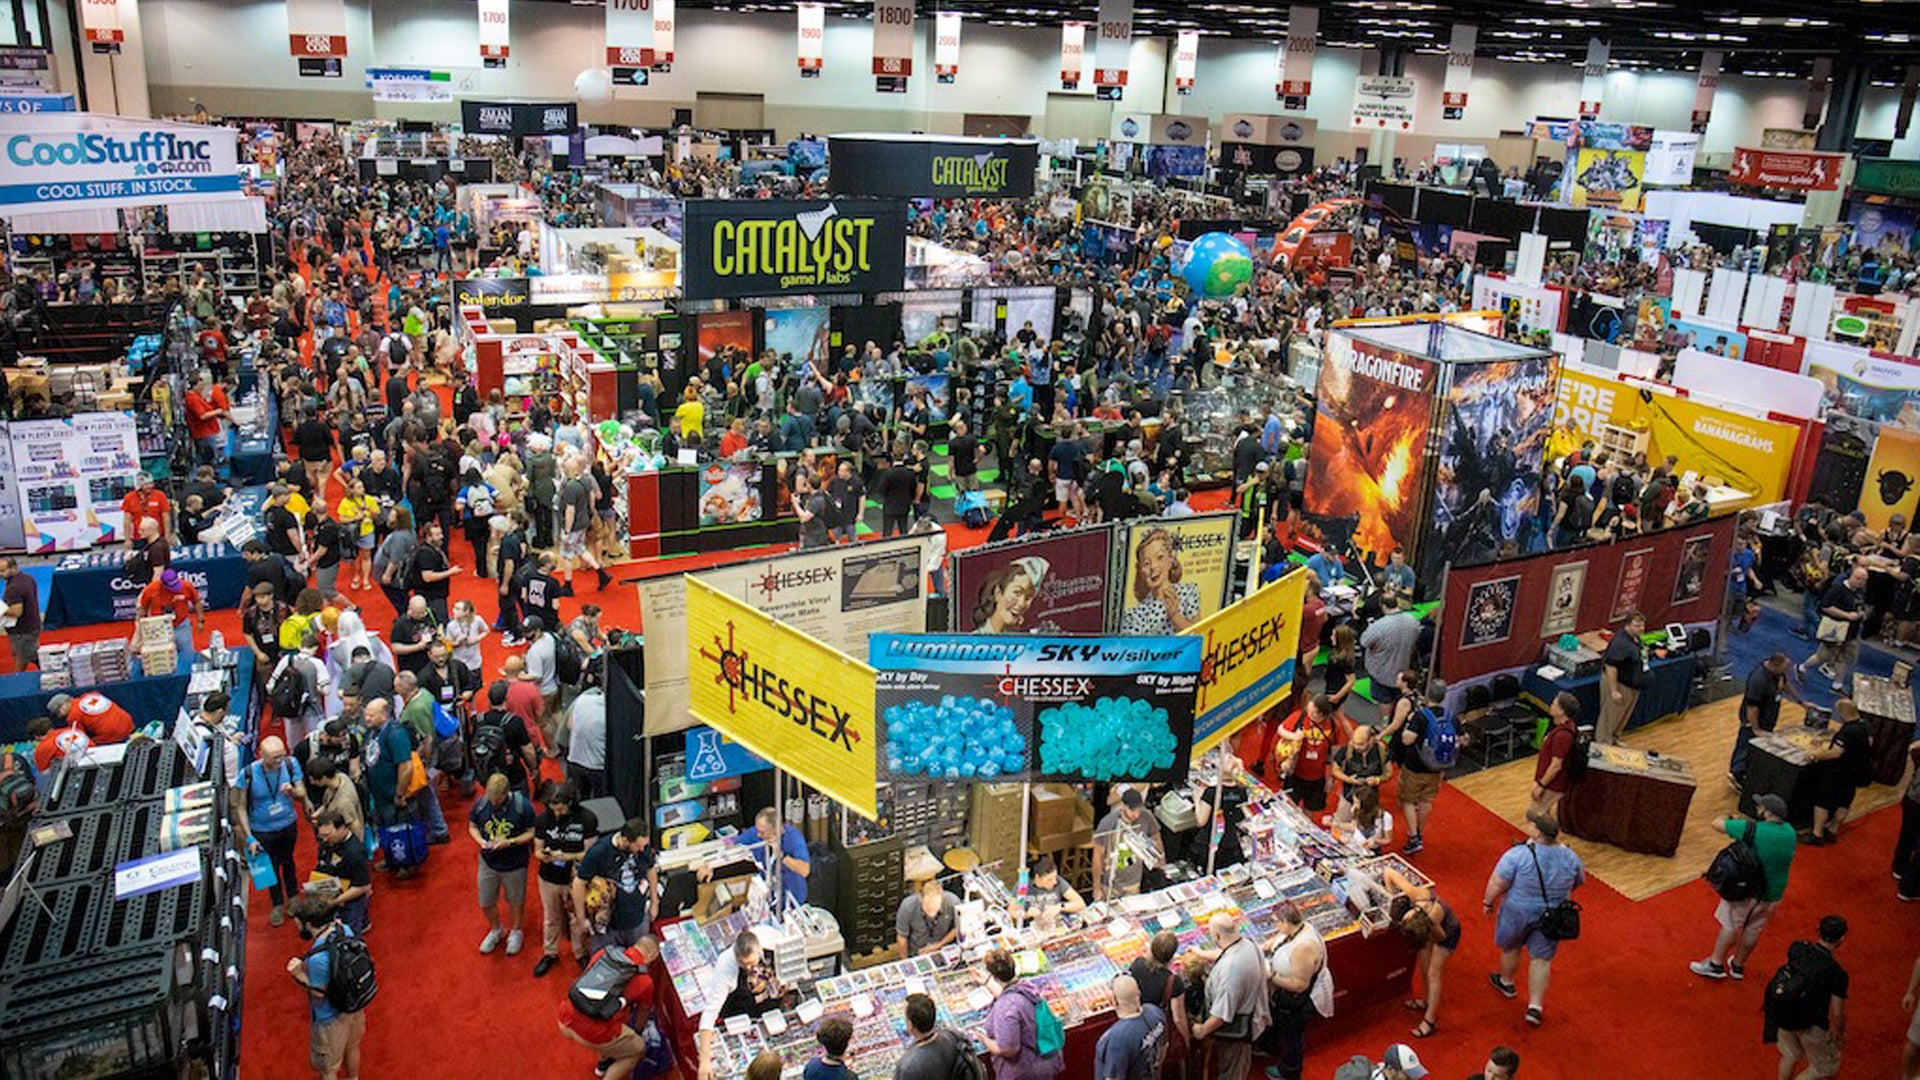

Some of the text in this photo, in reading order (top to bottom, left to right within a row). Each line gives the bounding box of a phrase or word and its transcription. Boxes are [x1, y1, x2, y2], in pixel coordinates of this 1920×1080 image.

[482, 11, 506, 24] 1700
[879, 6, 912, 25] 1800
[654, 21, 671, 31] 800
[801, 28, 821, 39] 1900
[1101, 22, 1129, 39] 1900
[305, 35, 331, 44] GEN
[305, 43, 331, 53] CON
[1289, 37, 1315, 52] 2000
[1449, 53, 1473, 67] 2100
[7, 132, 210, 166] CoolStuffInc
[931, 155, 1009, 191] CATALYST
[37, 179, 197, 200] COOL STUFF. IN STOCK.
[713, 219, 875, 285] CATALYST
[780, 274, 815, 289] game
[459, 288, 526, 307] Splendor
[1342, 349, 1424, 392] DRAGONFIRE
[1559, 376, 1616, 414] E'RE
[28, 431, 50, 440] PLAYER
[1693, 419, 1774, 454] BANANAGRAMS
[764, 564, 835, 590] CHESSEX
[807, 594, 832, 607] Vinyl
[1037, 644, 1100, 662] SKY
[1101, 648, 1182, 664] w/silver
[1200, 612, 1283, 687] CHESSEX
[909, 671, 929, 683] Day
[998, 677, 1090, 696] CHESSEX
[1136, 674, 1157, 685] SKY
[1170, 675, 1197, 687] Night
[719, 649, 853, 753] CHESSEX
